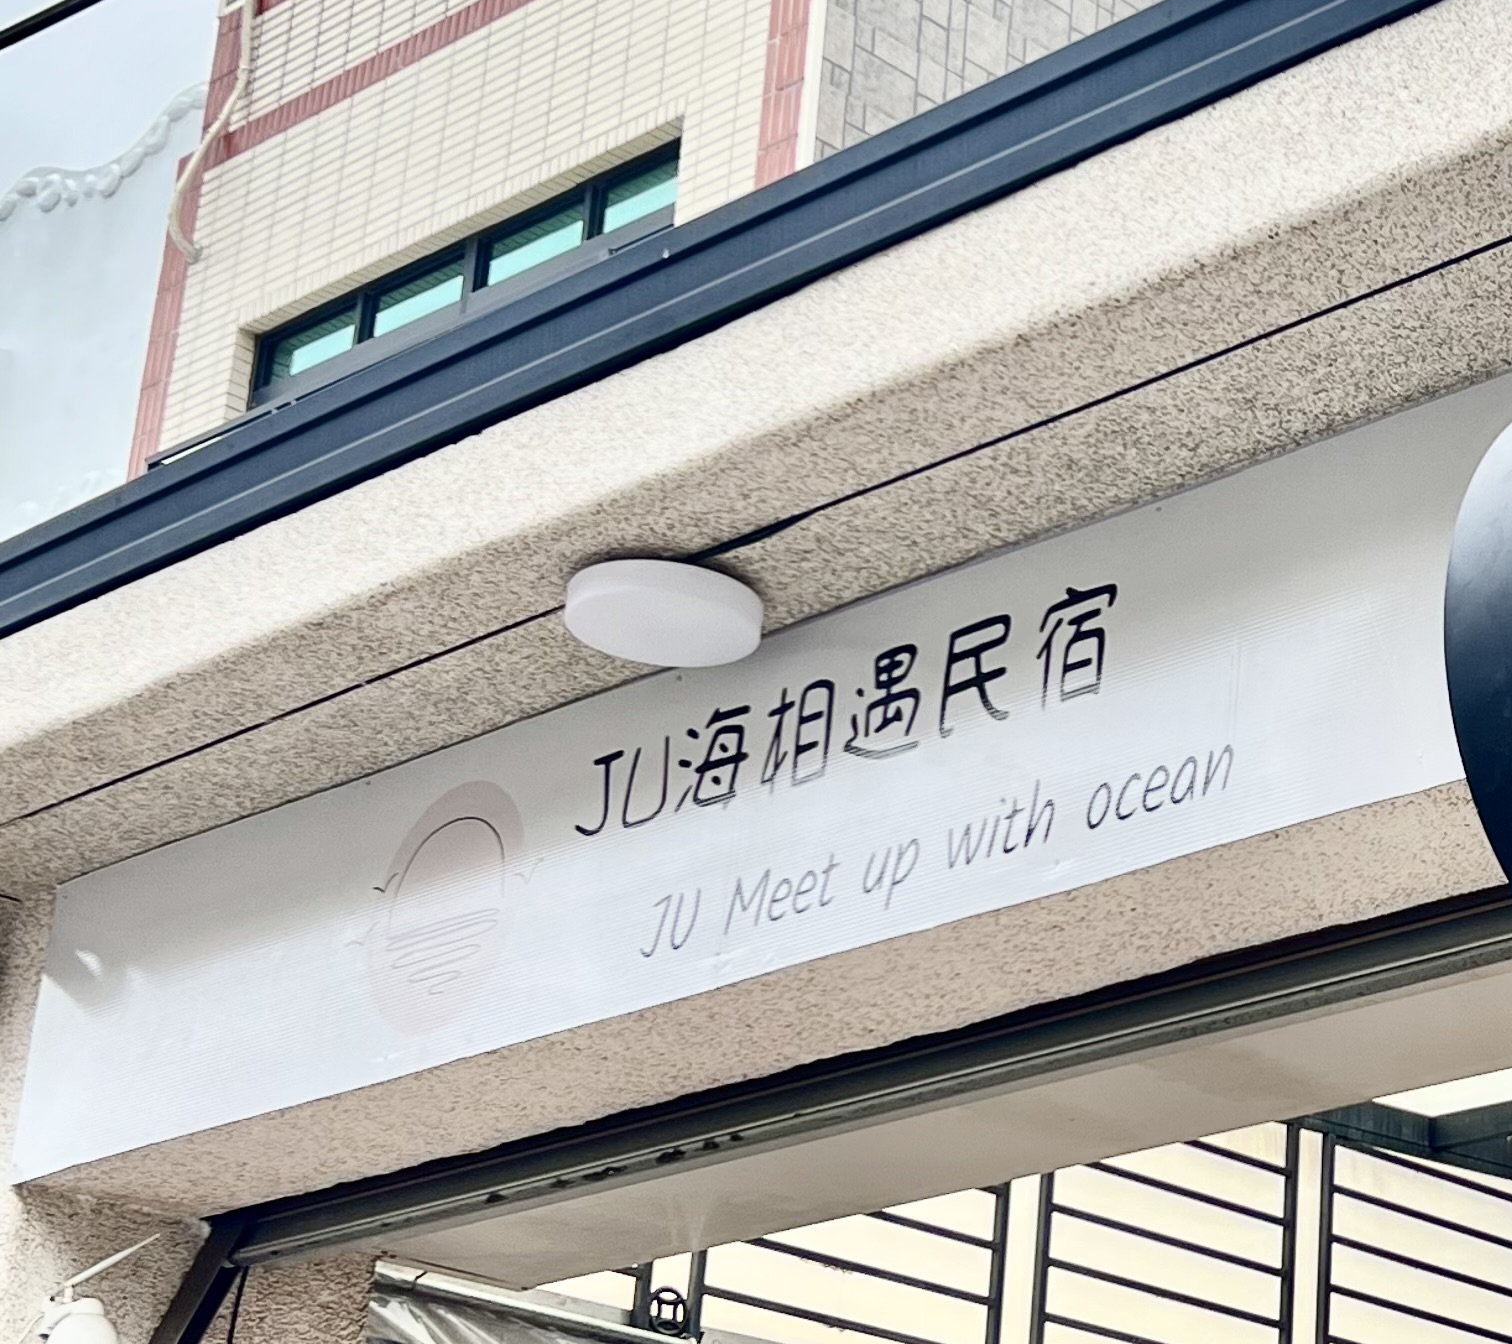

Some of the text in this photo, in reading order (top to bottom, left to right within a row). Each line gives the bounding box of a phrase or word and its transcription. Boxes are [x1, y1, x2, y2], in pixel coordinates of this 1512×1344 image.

[640, 743, 1234, 958] JU Meet up with ocean
